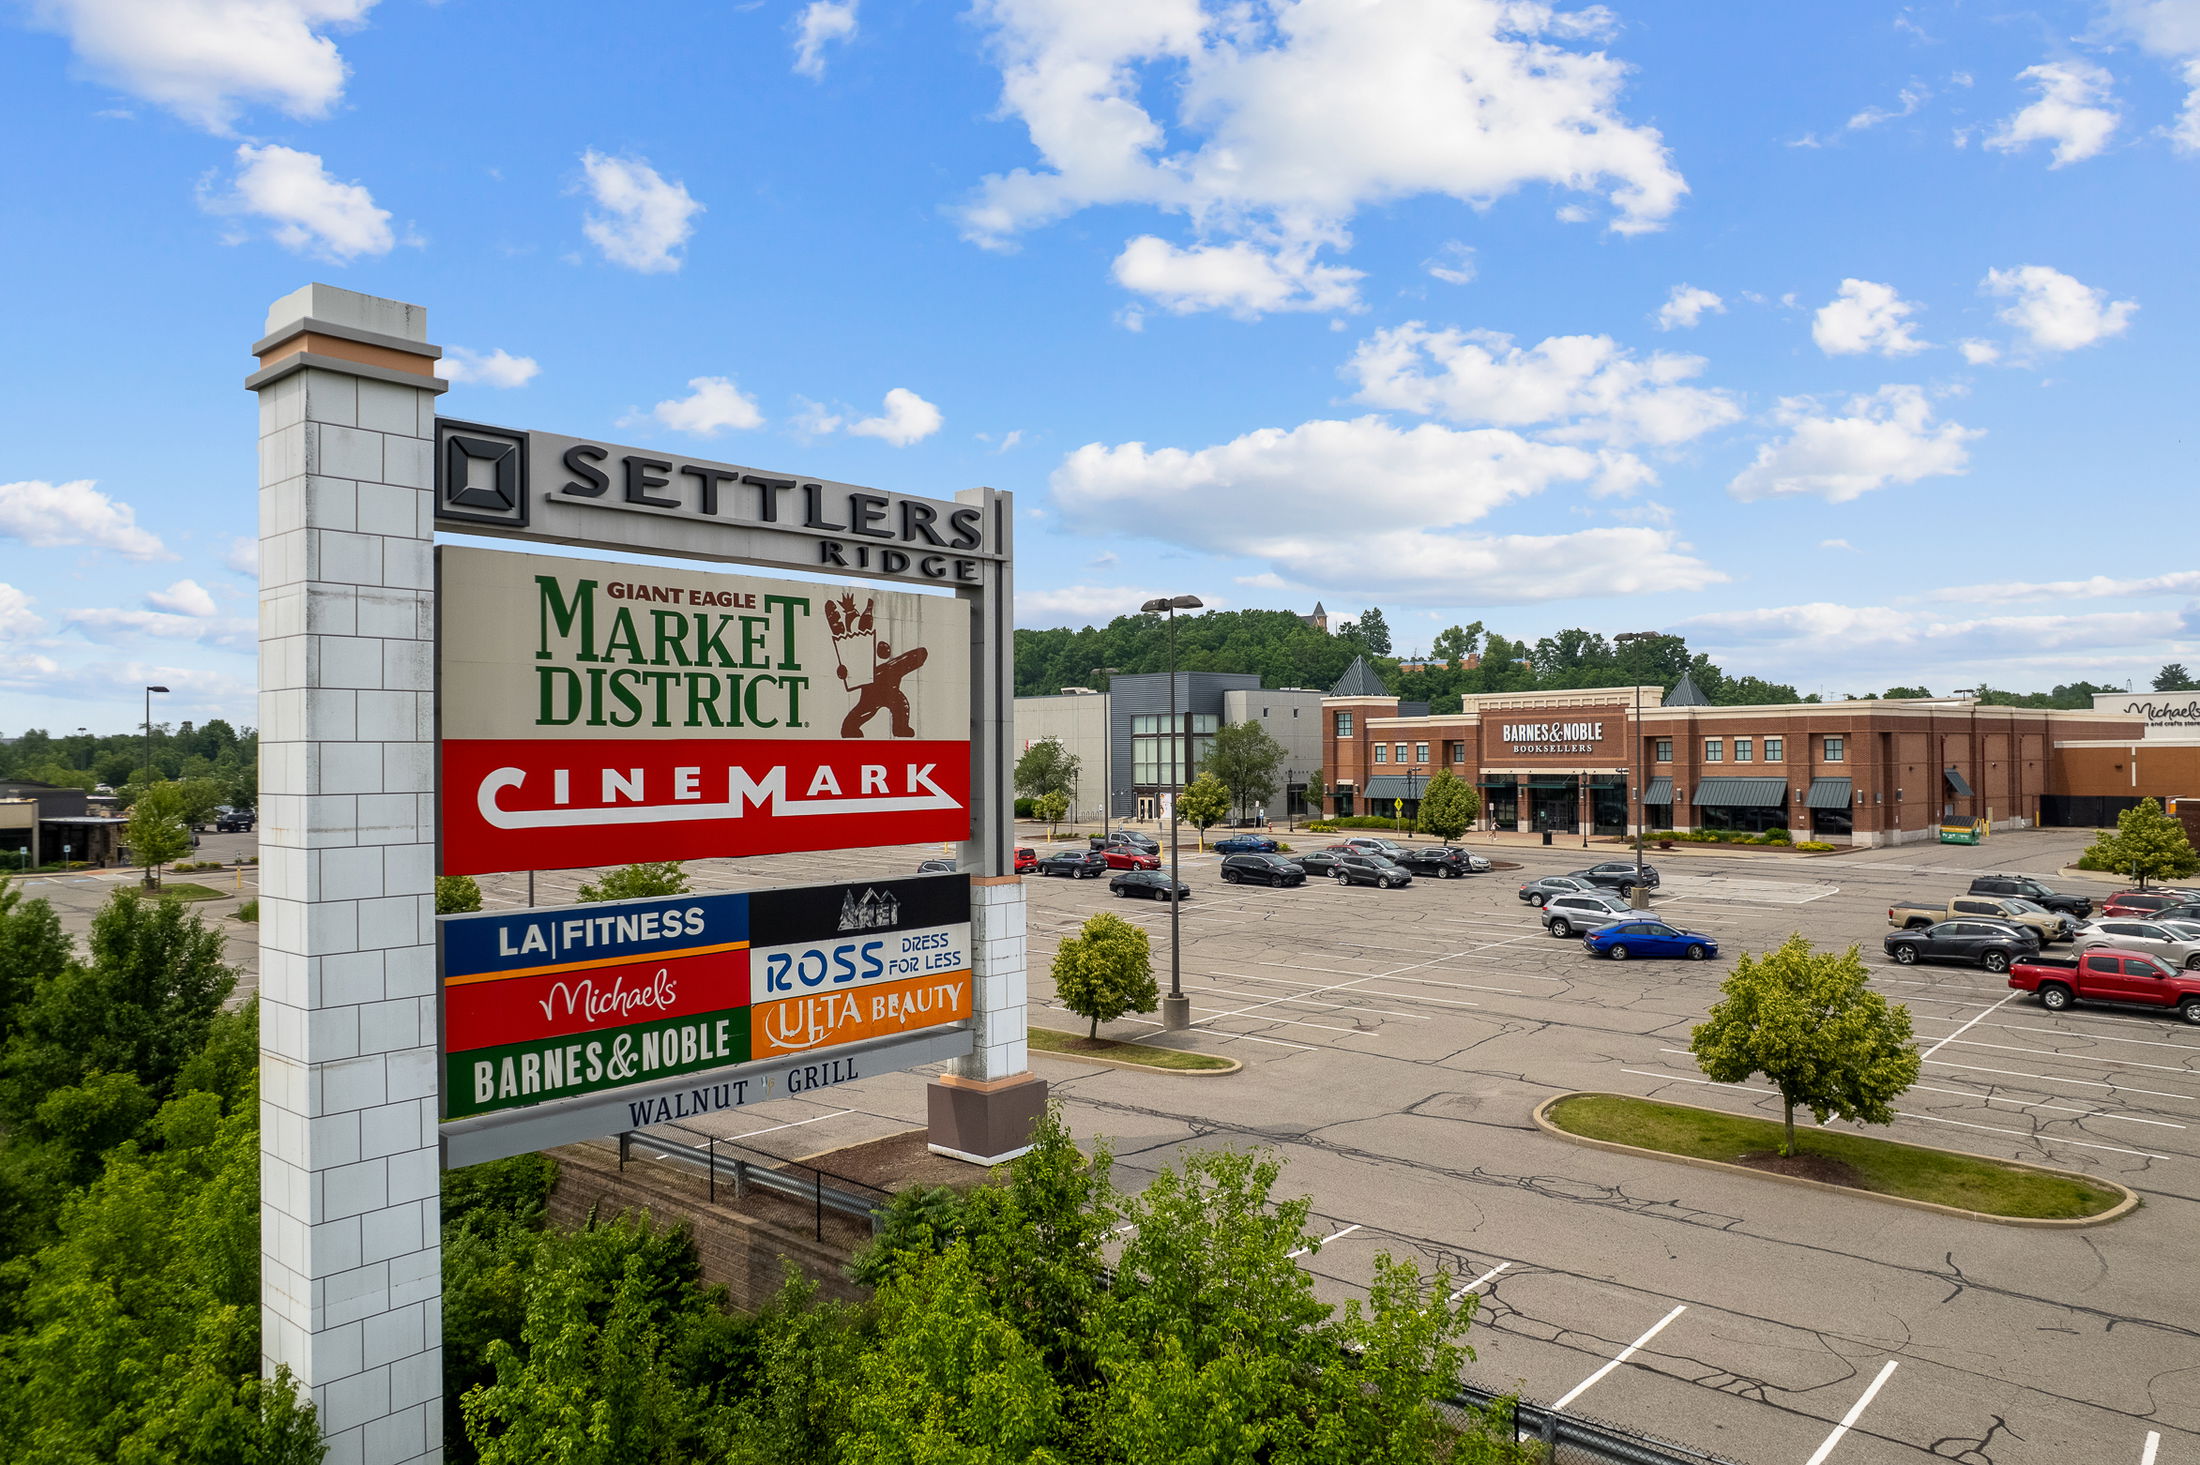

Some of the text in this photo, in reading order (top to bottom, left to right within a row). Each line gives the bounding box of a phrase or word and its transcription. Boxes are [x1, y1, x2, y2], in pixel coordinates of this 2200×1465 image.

[562, 444, 982, 550] SETTLERS
[820, 540, 979, 580] RIDGE
[607, 582, 756, 609] GIANT EAGLE
[535, 575, 810, 671] MARKET
[535, 665, 809, 728] DISTRICT
[2123, 701, 2200, 720] Michaels
[1513, 744, 1592, 753] BOOKSELLERS
[477, 764, 963, 829] CINEMARK
[889, 951, 961, 975] FOR LESS
[902, 932, 949, 953] DRESS
[767, 941, 884, 992] ROSS
[539, 968, 677, 1022] Michaels
[871, 982, 964, 1024] BEAUTY
[629, 1080, 749, 1127] WALNUT
[788, 1058, 859, 1093] GRILL
